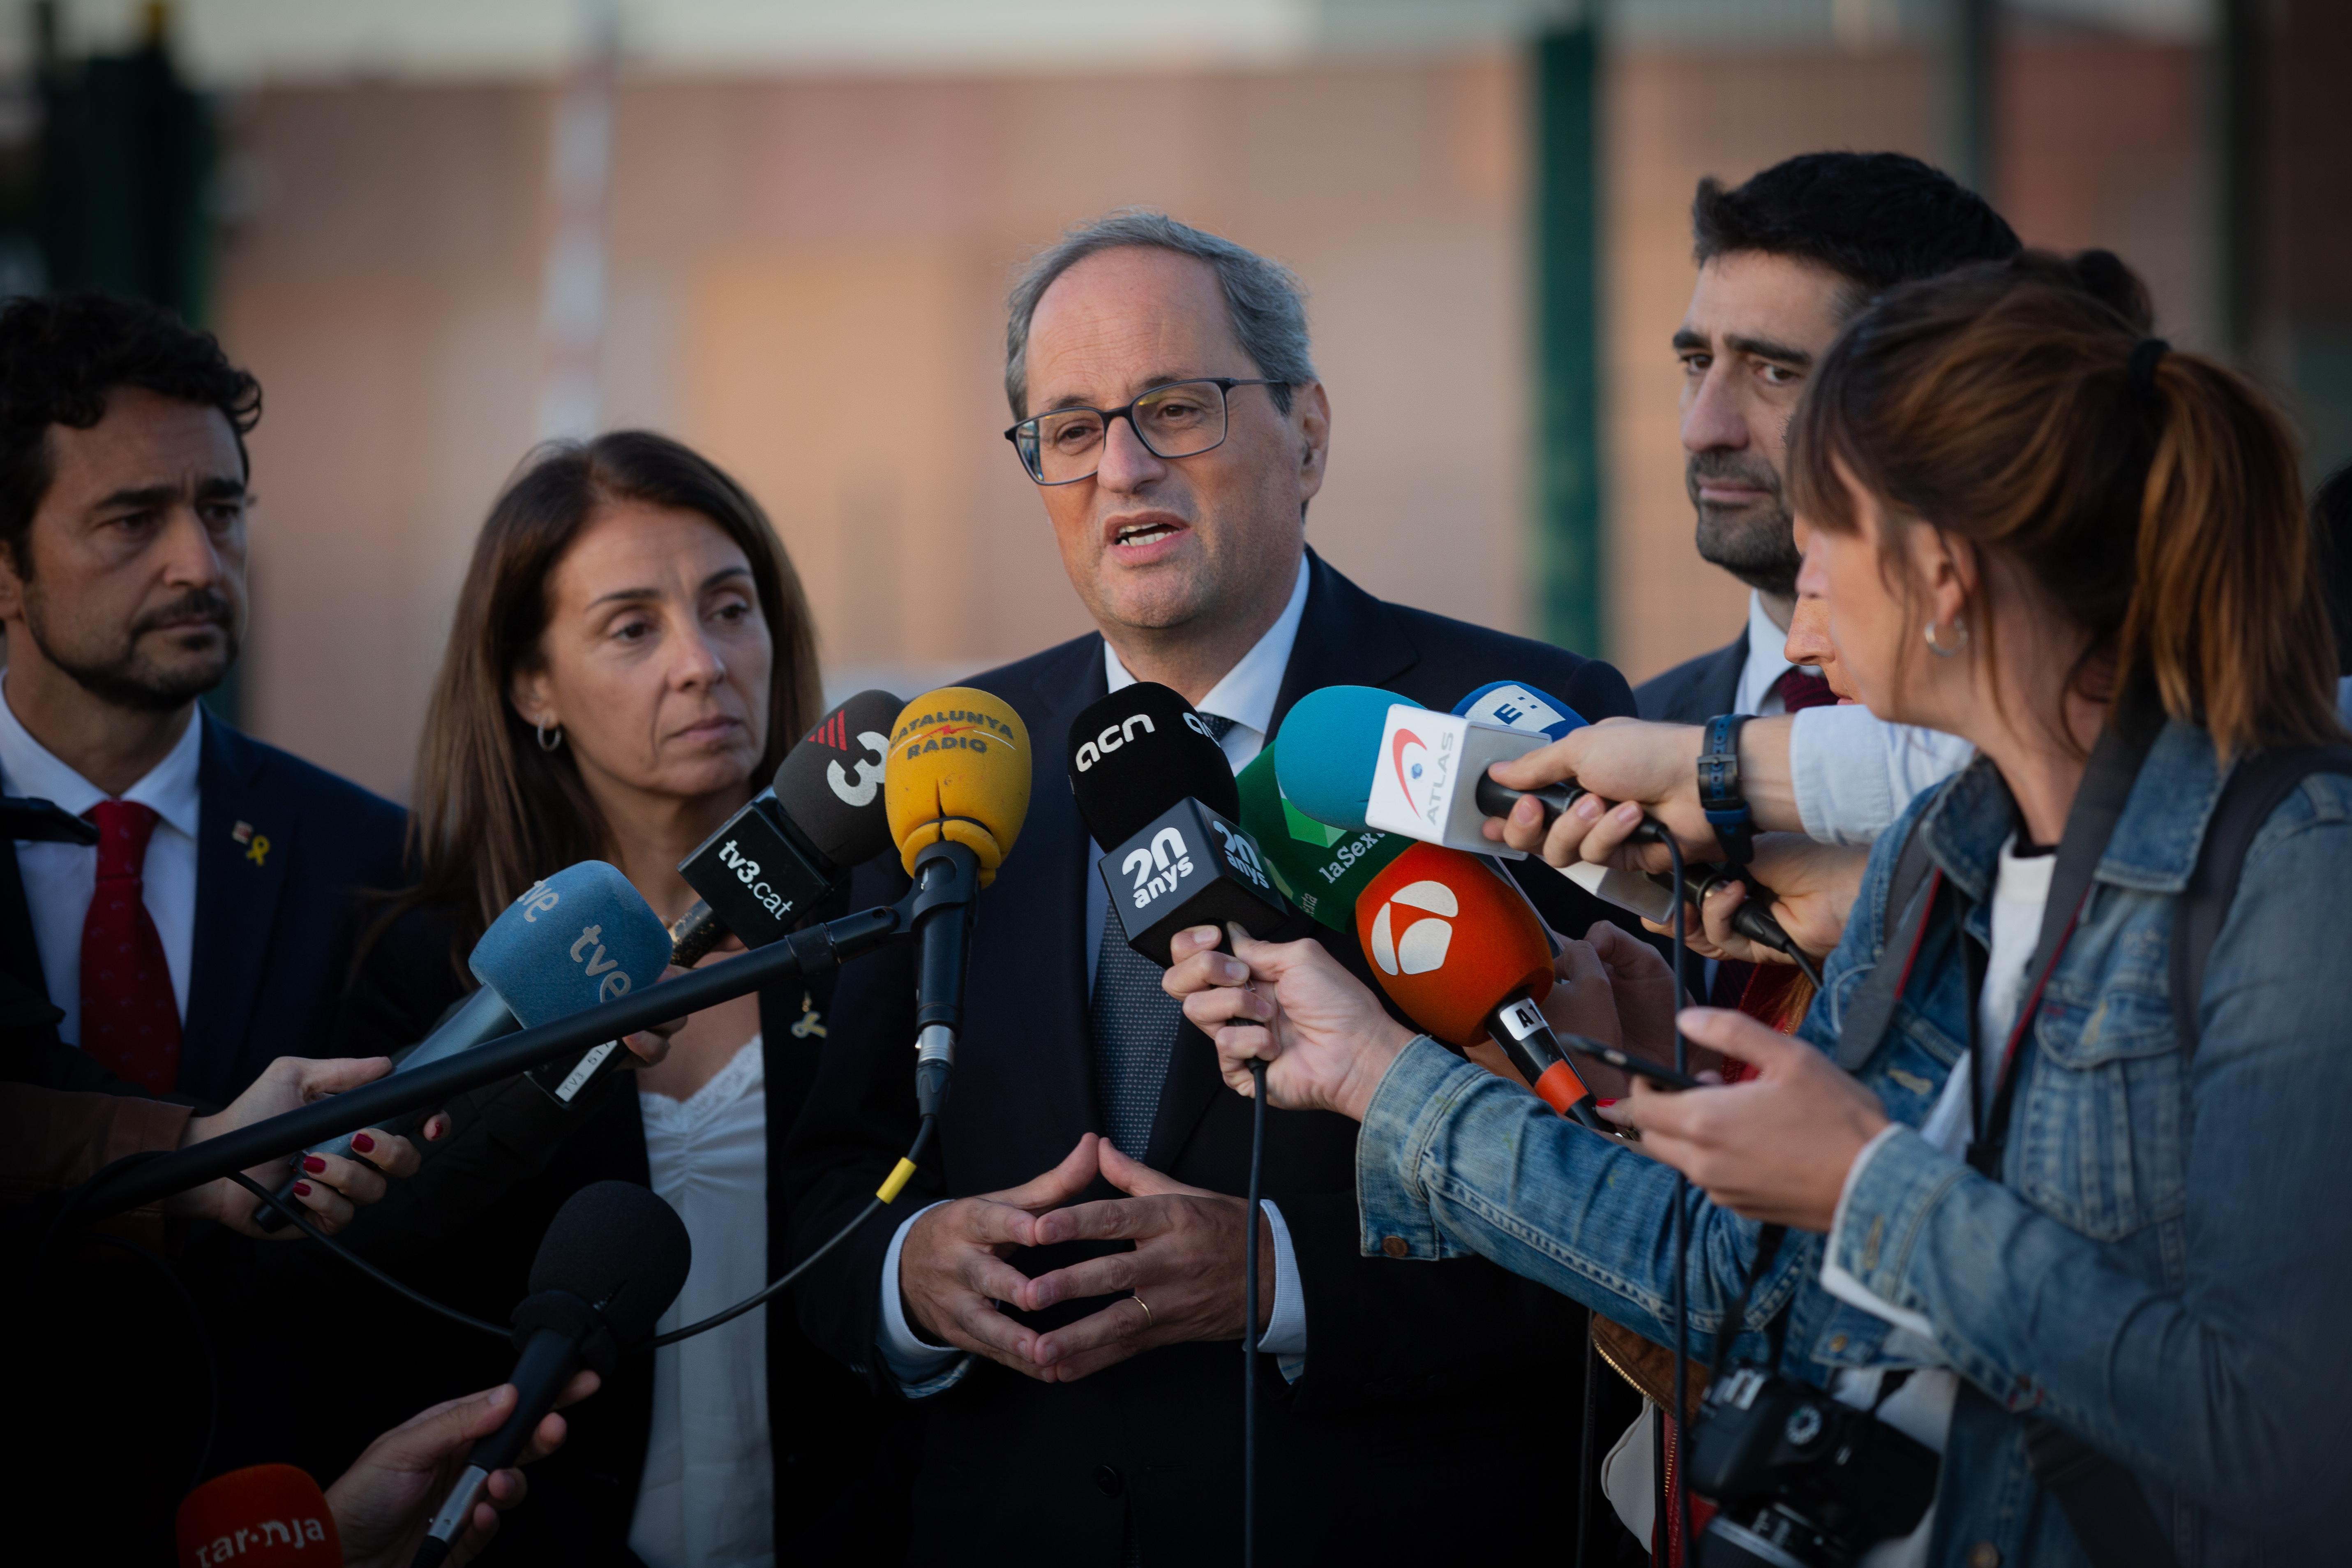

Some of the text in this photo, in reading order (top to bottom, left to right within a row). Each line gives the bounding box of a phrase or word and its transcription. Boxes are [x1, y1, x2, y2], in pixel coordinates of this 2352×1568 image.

[890, 710, 1014, 749] CATALUNYA
[907, 737, 987, 760] RADIO
[1076, 714, 1156, 772] acn
[1426, 732, 1454, 826] ATLAS
[718, 839, 793, 920] tv3.cat
[1132, 856, 1194, 908] anys
[1224, 850, 1270, 889] anys
[570, 925, 632, 1003] tve
